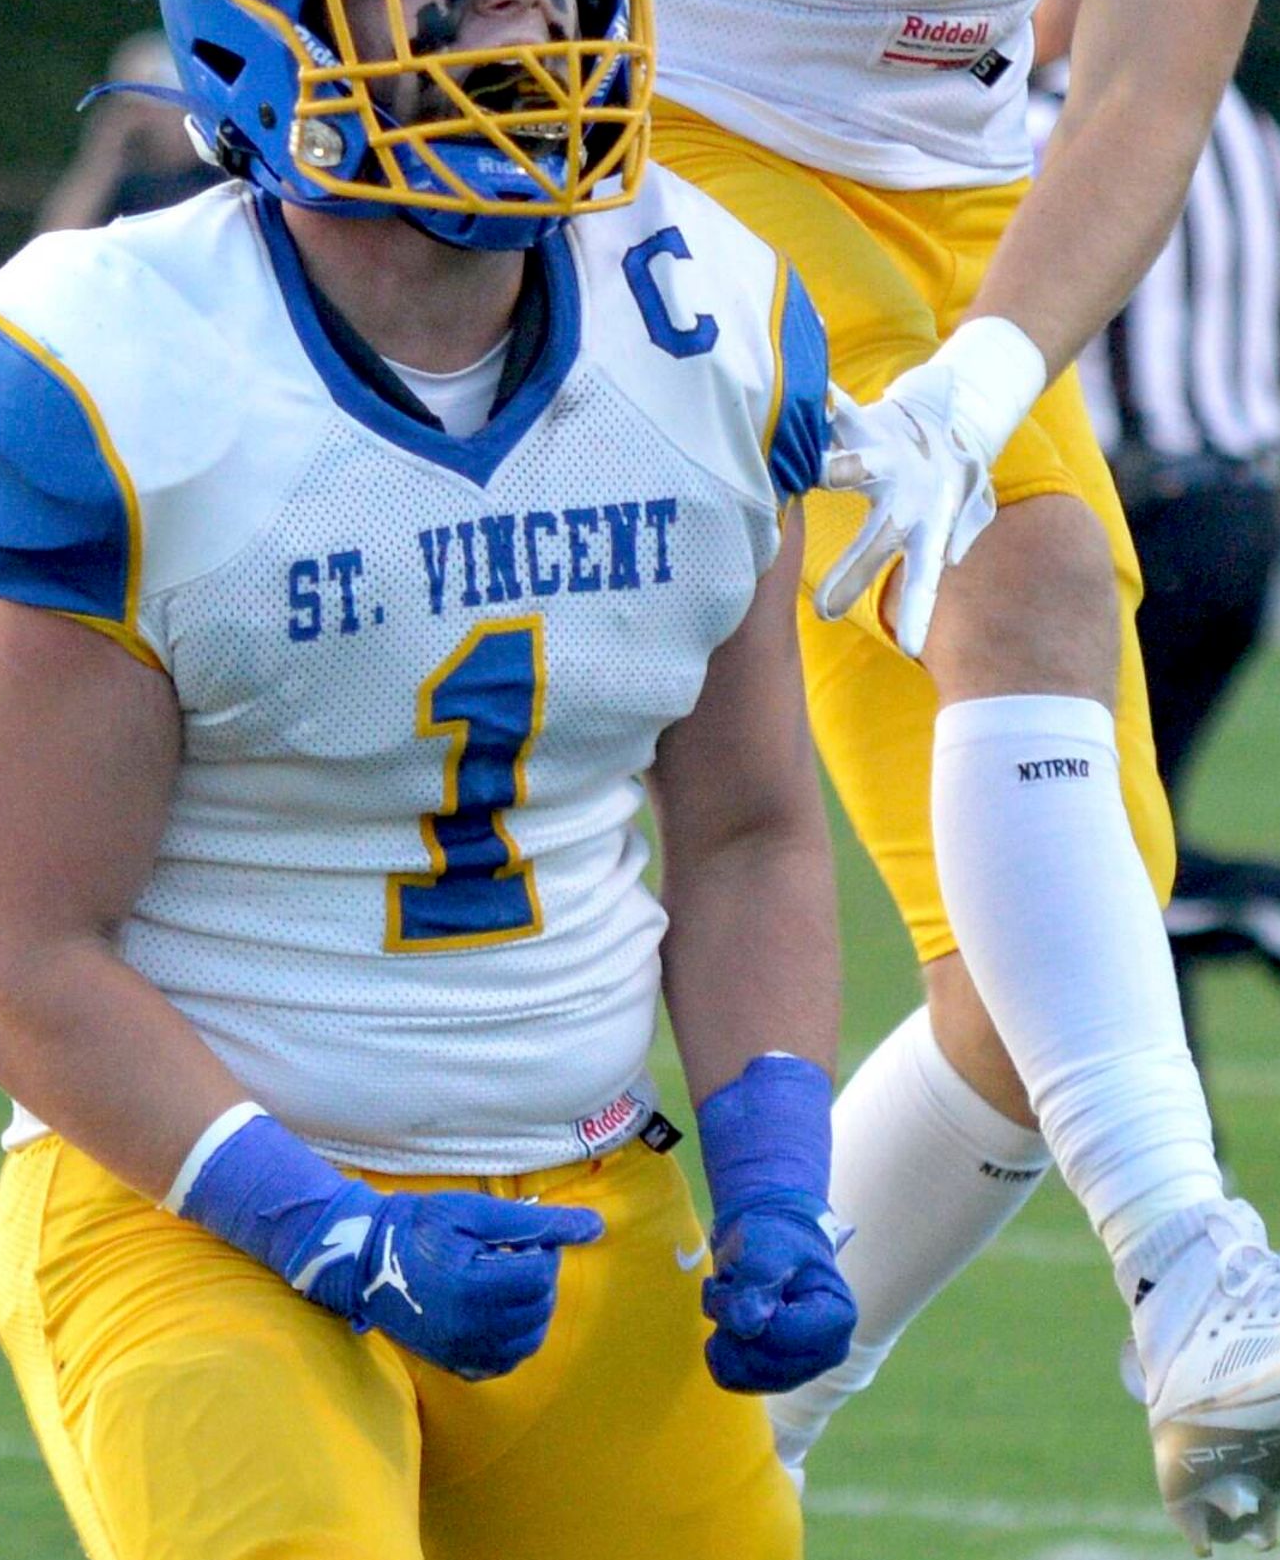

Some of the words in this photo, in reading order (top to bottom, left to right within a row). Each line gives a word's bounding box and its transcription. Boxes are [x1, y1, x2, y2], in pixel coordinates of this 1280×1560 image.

[902, 15, 989, 45] Riddell
[621, 225, 719, 360] C
[288, 548, 385, 640] ST.
[419, 497, 677, 616] VINCENT
[382, 613, 548, 953] 1
